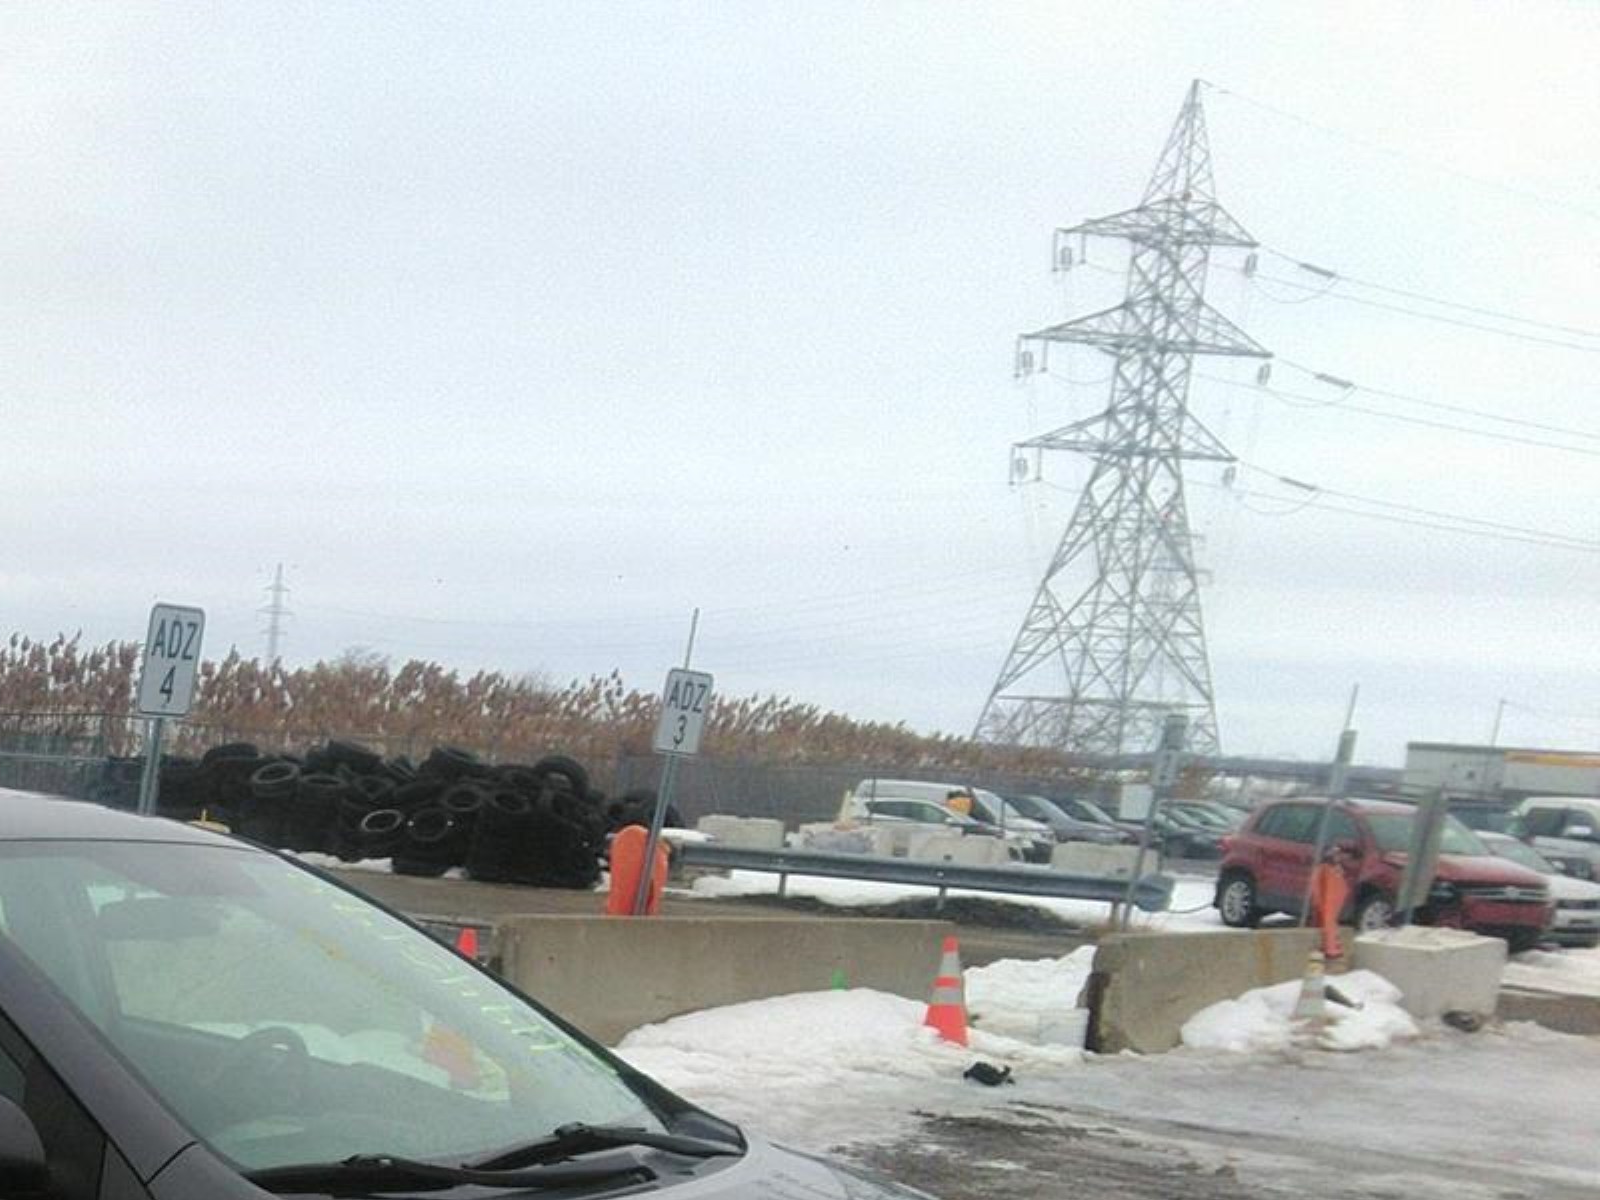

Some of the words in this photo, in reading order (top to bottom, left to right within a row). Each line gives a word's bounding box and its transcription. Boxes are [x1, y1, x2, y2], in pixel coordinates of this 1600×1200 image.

[151, 618, 199, 660] ADZ
[159, 665, 176, 704] 4
[668, 680, 708, 713] ADZ
[673, 714, 687, 745] 3
